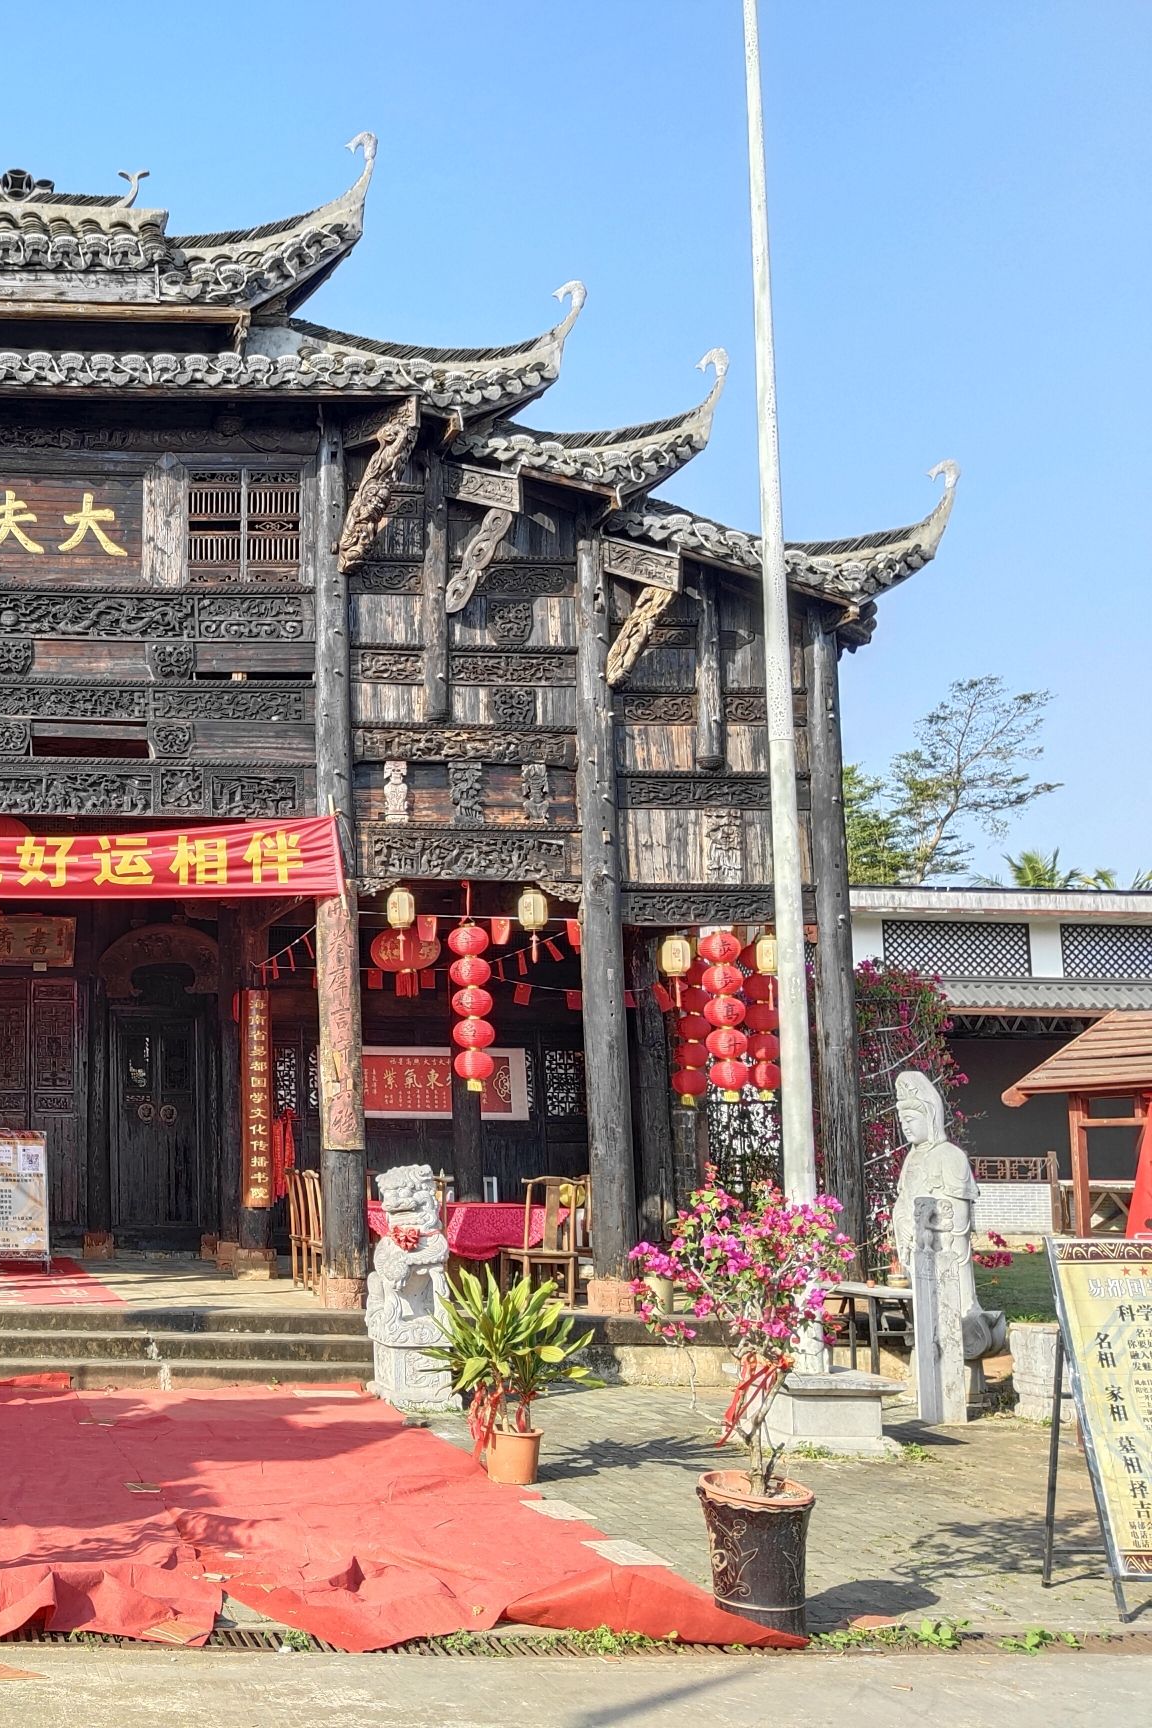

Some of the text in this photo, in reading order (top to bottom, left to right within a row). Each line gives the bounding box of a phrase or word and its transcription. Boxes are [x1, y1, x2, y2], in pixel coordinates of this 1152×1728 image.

[248, 998, 270, 1199] 海南省易都国学文化传播书院
[1088, 1277, 1152, 1298] 易都国
[1095, 1332, 1117, 1369] 名相
[1104, 1385, 1129, 1421] 家相
[1115, 1436, 1143, 1474] 墓相
[1130, 1480, 1152, 1518] 择吉
